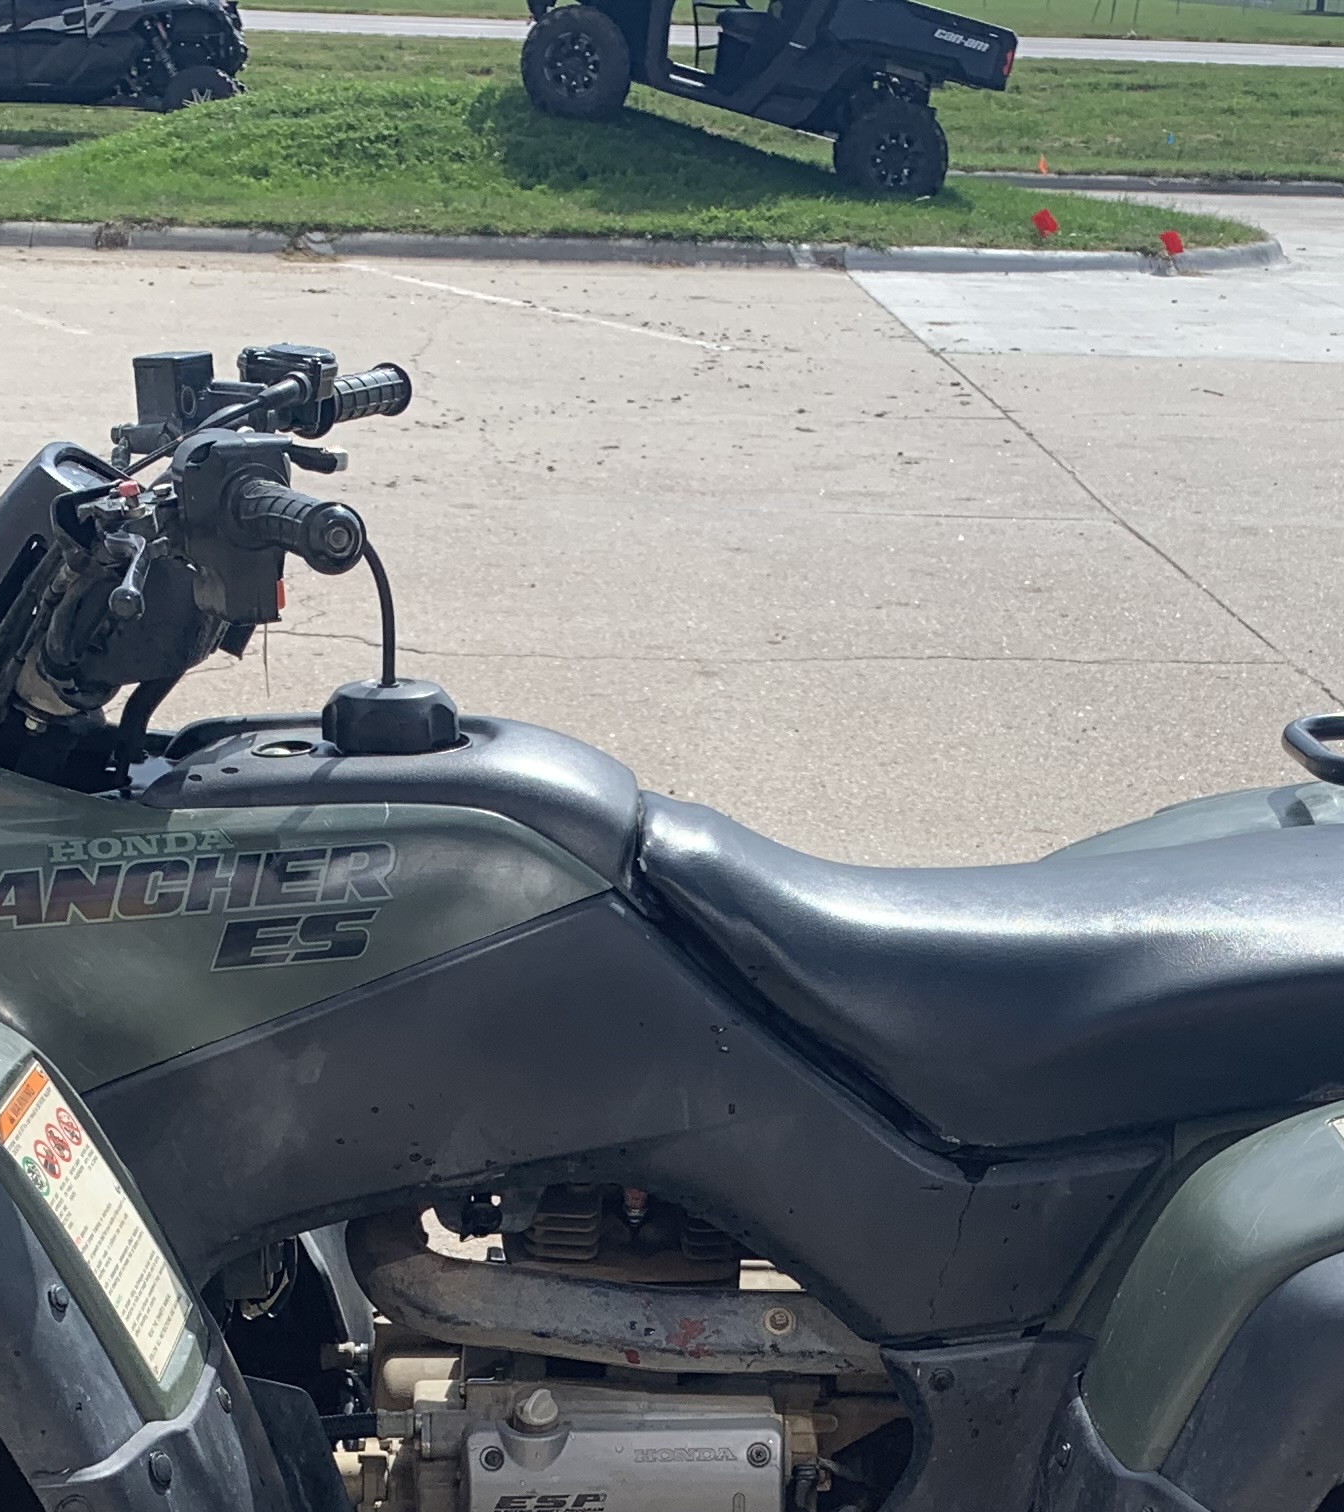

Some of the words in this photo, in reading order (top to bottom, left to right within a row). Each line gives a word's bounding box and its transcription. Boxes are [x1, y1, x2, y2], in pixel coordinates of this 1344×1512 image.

[47, 827, 236, 863] HONDA
[210, 908, 382, 973] ES
[634, 1447, 738, 1463] HONDA
[494, 1493, 607, 1509] ESP
